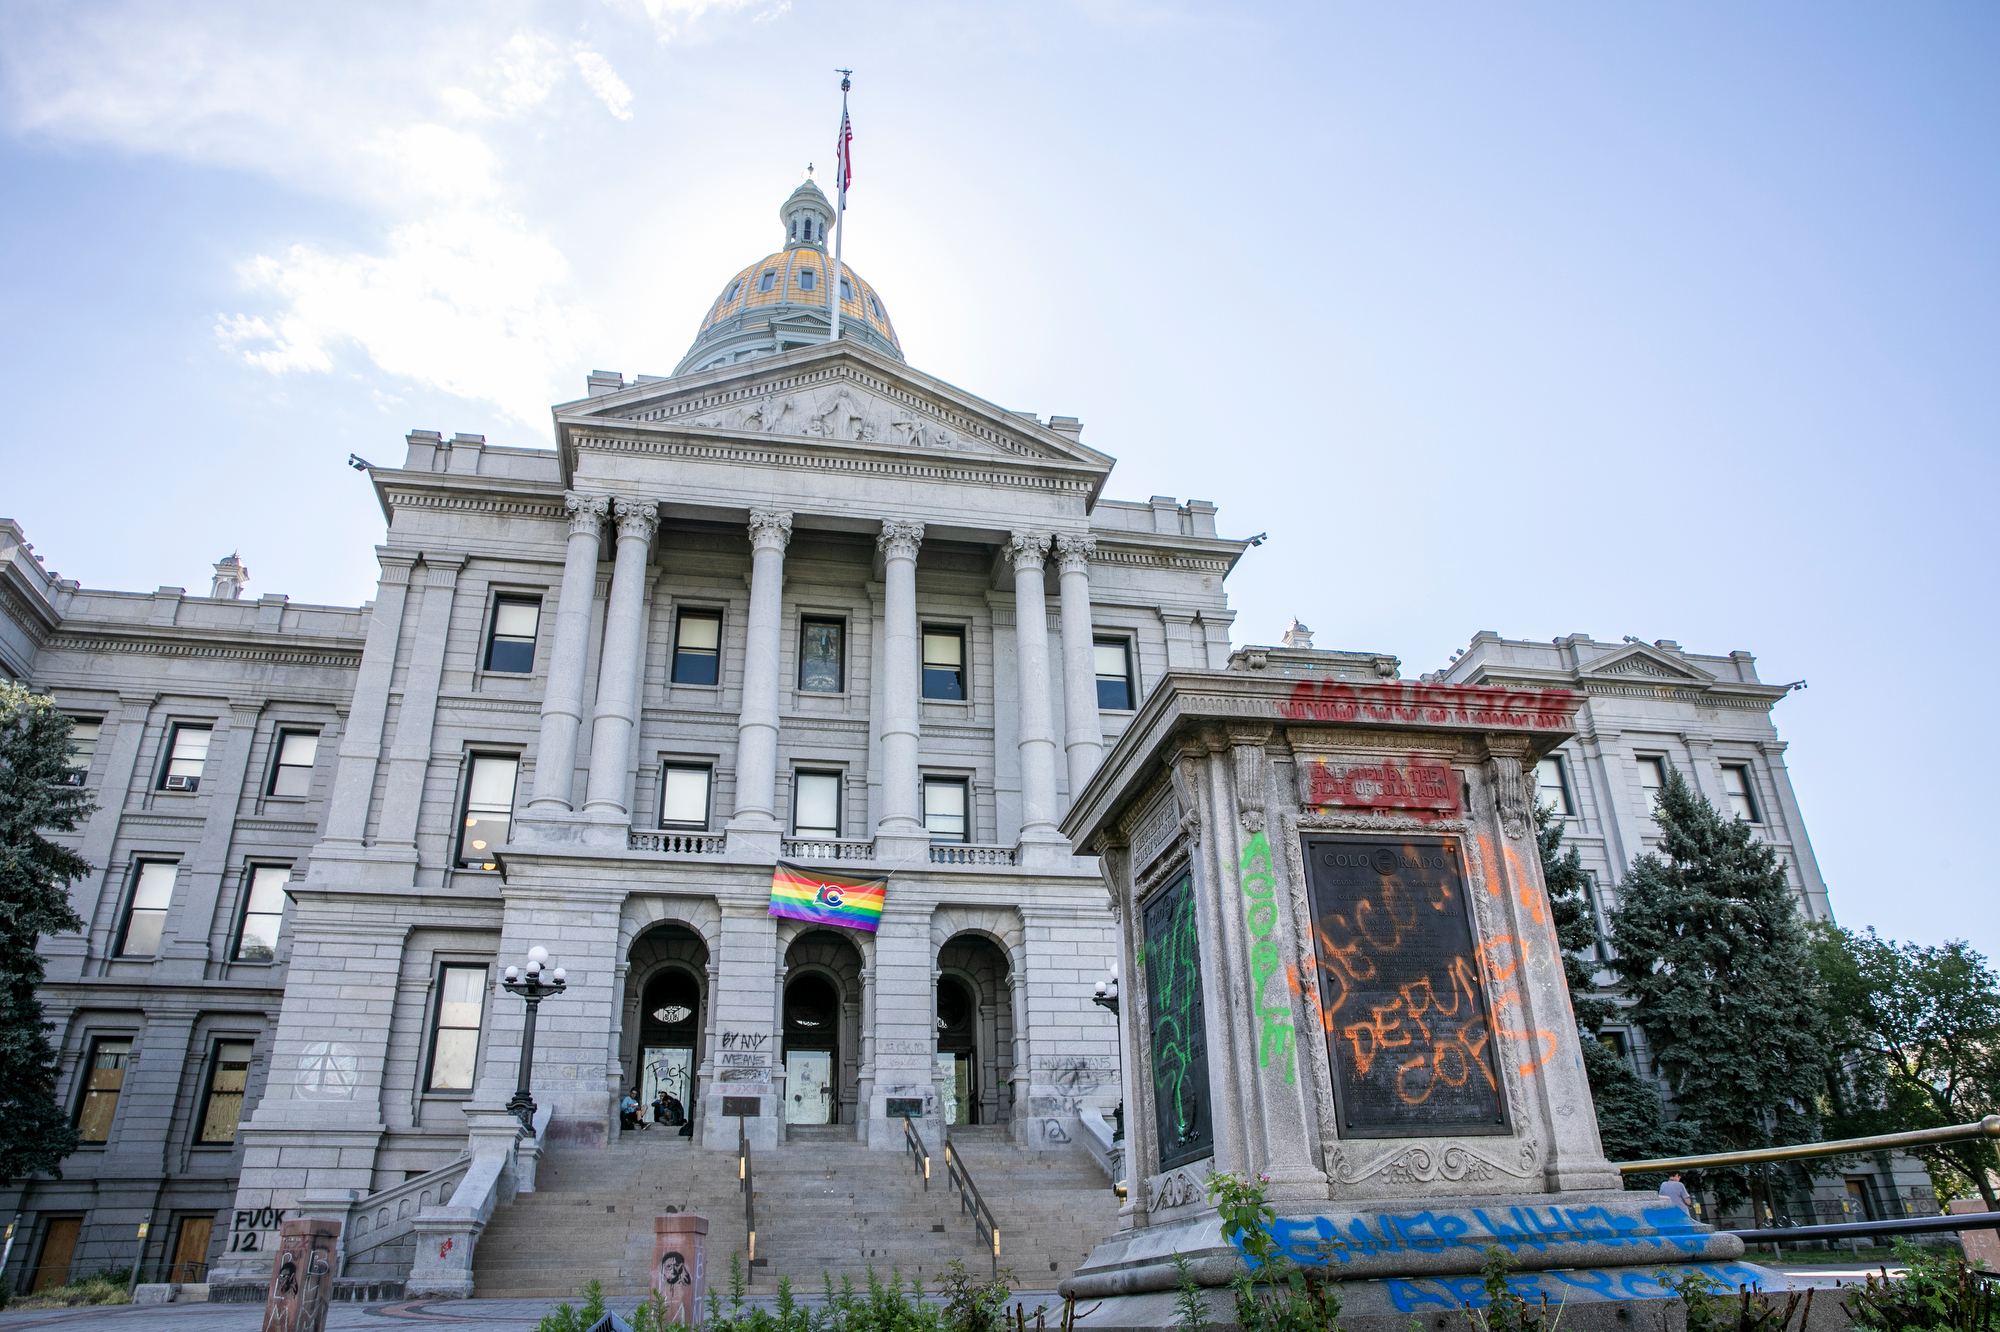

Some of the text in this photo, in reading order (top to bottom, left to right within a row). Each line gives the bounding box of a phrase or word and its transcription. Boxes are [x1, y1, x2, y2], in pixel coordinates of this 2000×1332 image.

[1314, 765, 1439, 784] ERECTED BY THE
[1311, 780, 1352, 795] STATE
[1355, 781, 1372, 796] OF
[722, 1031, 768, 1051] BY ANY
[1397, 988, 1557, 1112] COPS
[722, 1053, 766, 1066] MEANS
[234, 1206, 286, 1232] FUCK
[231, 1232, 258, 1253] 12
